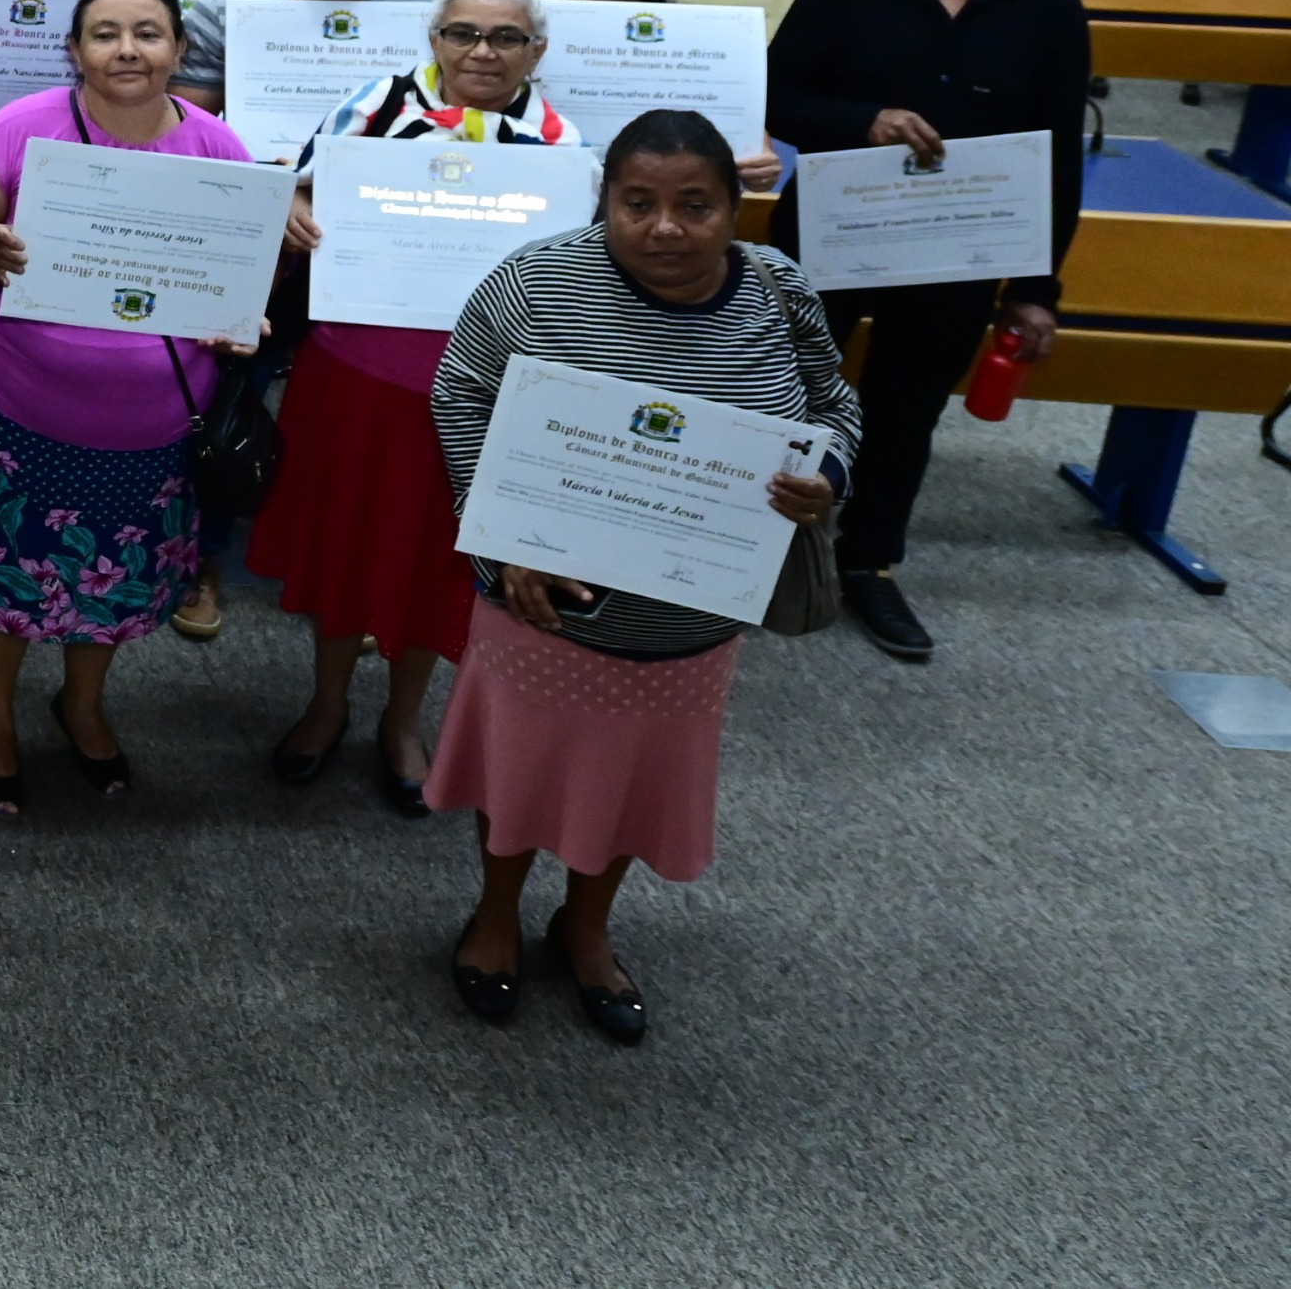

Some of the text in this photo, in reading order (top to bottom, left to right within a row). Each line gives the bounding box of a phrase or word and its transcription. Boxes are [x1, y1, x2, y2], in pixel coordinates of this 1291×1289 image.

[14, 69, 62, 78] Nascimento
[264, 85, 292, 93] Carlos
[91, 223, 208, 245] Ariete Pereira da Silva
[546, 419, 607, 443] Diploma
[611, 434, 627, 449] de
[631, 439, 678, 462] Honra
[682, 455, 700, 467] ao
[703, 460, 756, 482] Mérito
[558, 477, 603, 496] Márcia
[653, 501, 668, 512] de
[670, 507, 704, 522] Jesus
